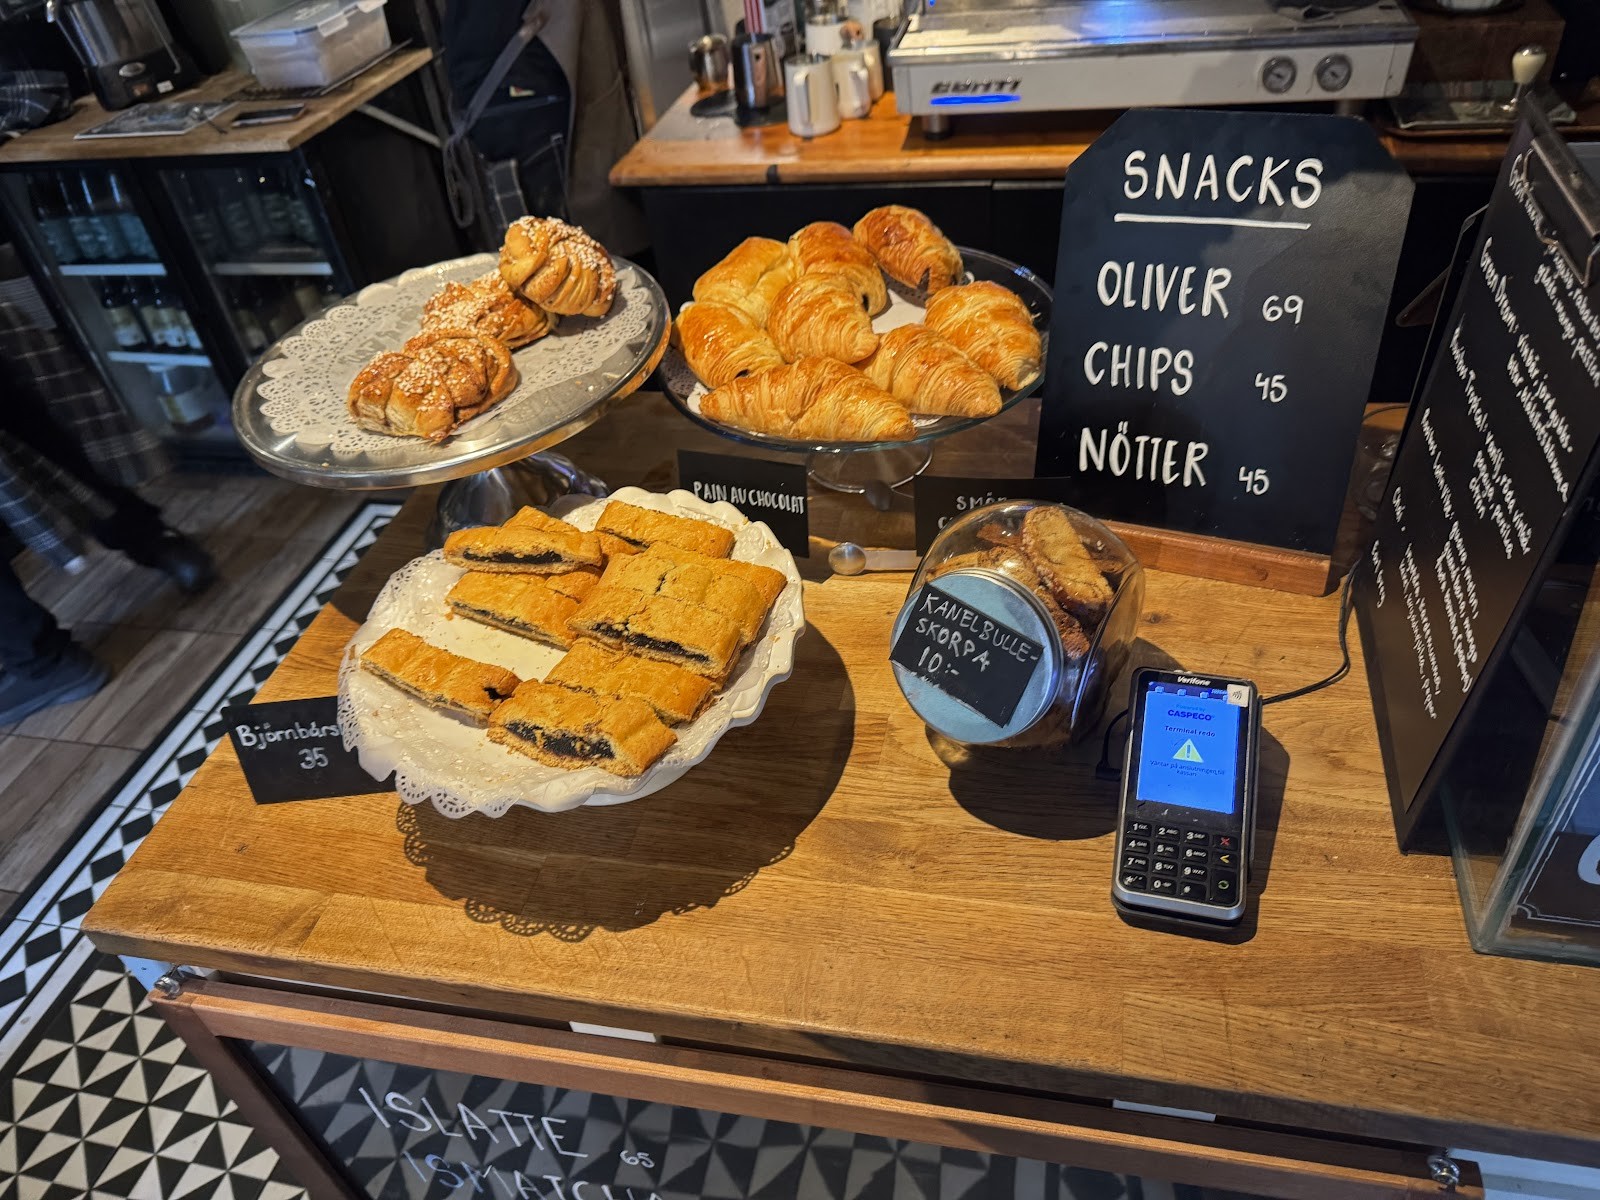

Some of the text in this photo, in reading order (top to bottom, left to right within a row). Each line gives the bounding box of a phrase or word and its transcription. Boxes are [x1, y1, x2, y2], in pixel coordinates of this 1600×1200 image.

[1124, 150, 1323, 209] SNACKS
[1481, 237, 1498, 292] Green
[1097, 260, 1304, 324] OLIVER 69
[1083, 341, 1287, 402] CHIPS 45
[1079, 420, 1269, 495] NÖTTER 45
[693, 481, 804, 514] PAIN AU CHOCOLAT
[956, 491, 1007, 510] SMÖ
[919, 593, 1038, 662] KANELBULLE-
[916, 618, 990, 672] SKORPA
[918, 646, 959, 675] 10:-
[1177, 676, 1211, 686] Verifone
[1168, 709, 1212, 721] CASPECO
[1165, 725, 1197, 735] Terminal
[299, 747, 329, 769] 35
[1132, 823, 1138, 831] 1
[1158, 827, 1165, 835] 2
[1129, 840, 1136, 848] 4
[1156, 845, 1164, 853] 5
[1185, 849, 1193, 857] 6
[1127, 857, 1134, 865] 7
[1155, 862, 1162, 870] 8
[1184, 867, 1191, 875] 9
[358, 1087, 655, 1168] ISLATTE 65
